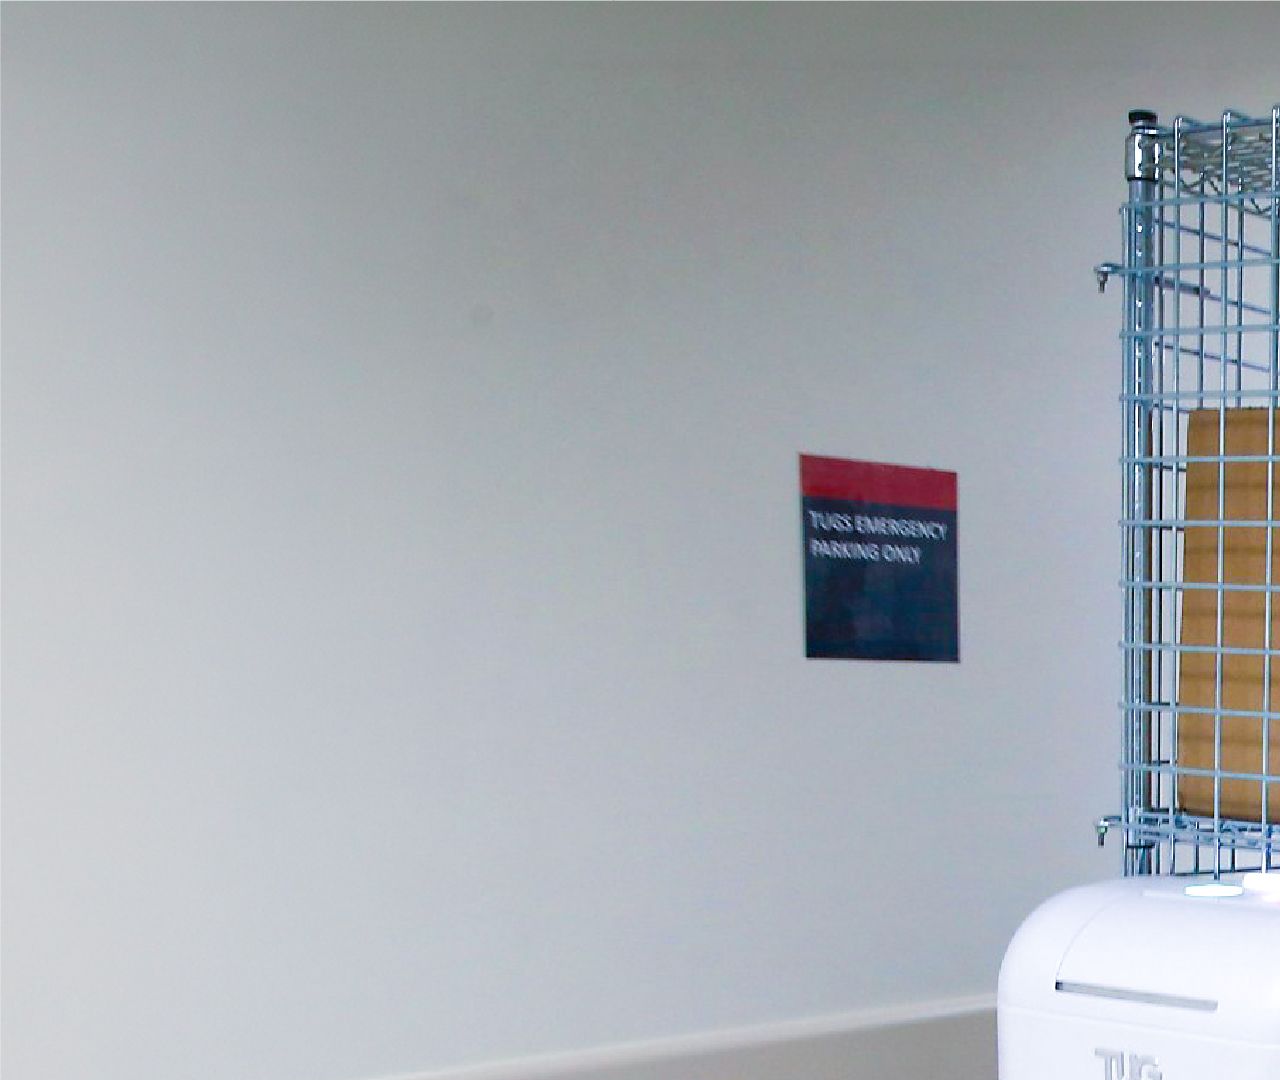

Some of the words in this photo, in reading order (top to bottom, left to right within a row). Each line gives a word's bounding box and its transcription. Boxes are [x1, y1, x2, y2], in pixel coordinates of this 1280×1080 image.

[808, 510, 853, 532] TUGS
[854, 514, 947, 540] EMERGENCY
[809, 539, 880, 561] PARKING
[881, 543, 921, 564] ONLY
